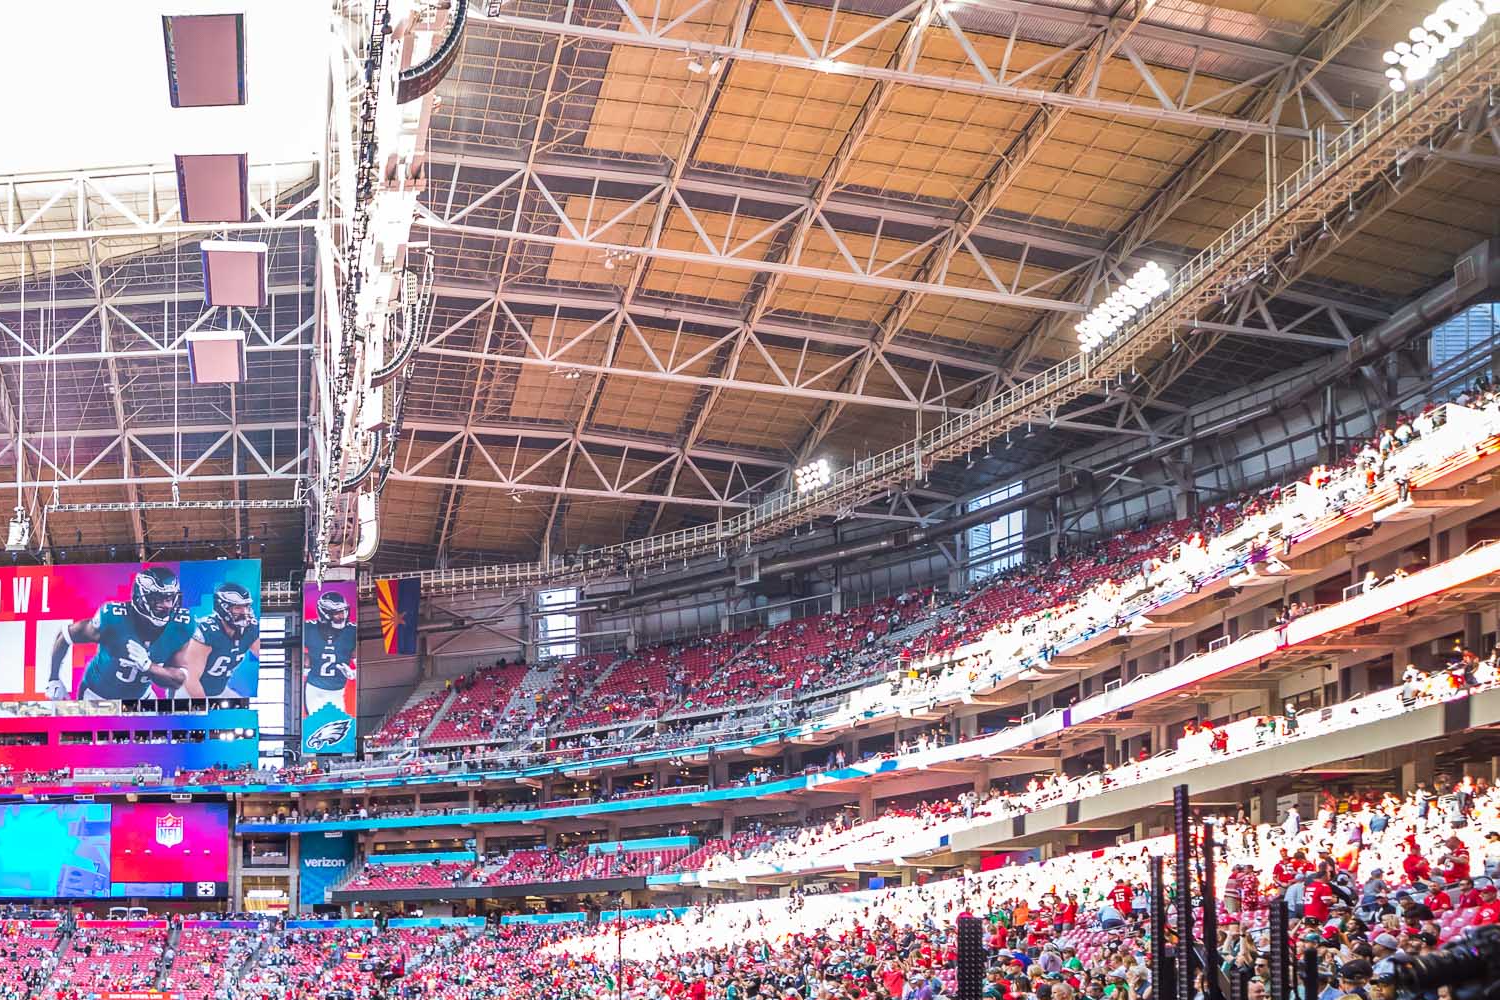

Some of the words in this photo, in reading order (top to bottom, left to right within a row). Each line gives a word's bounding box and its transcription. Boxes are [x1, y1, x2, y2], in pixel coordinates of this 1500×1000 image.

[320, 653, 337, 677] 2
[304, 856, 346, 868] verizon
[1114, 892, 1126, 903] 15
